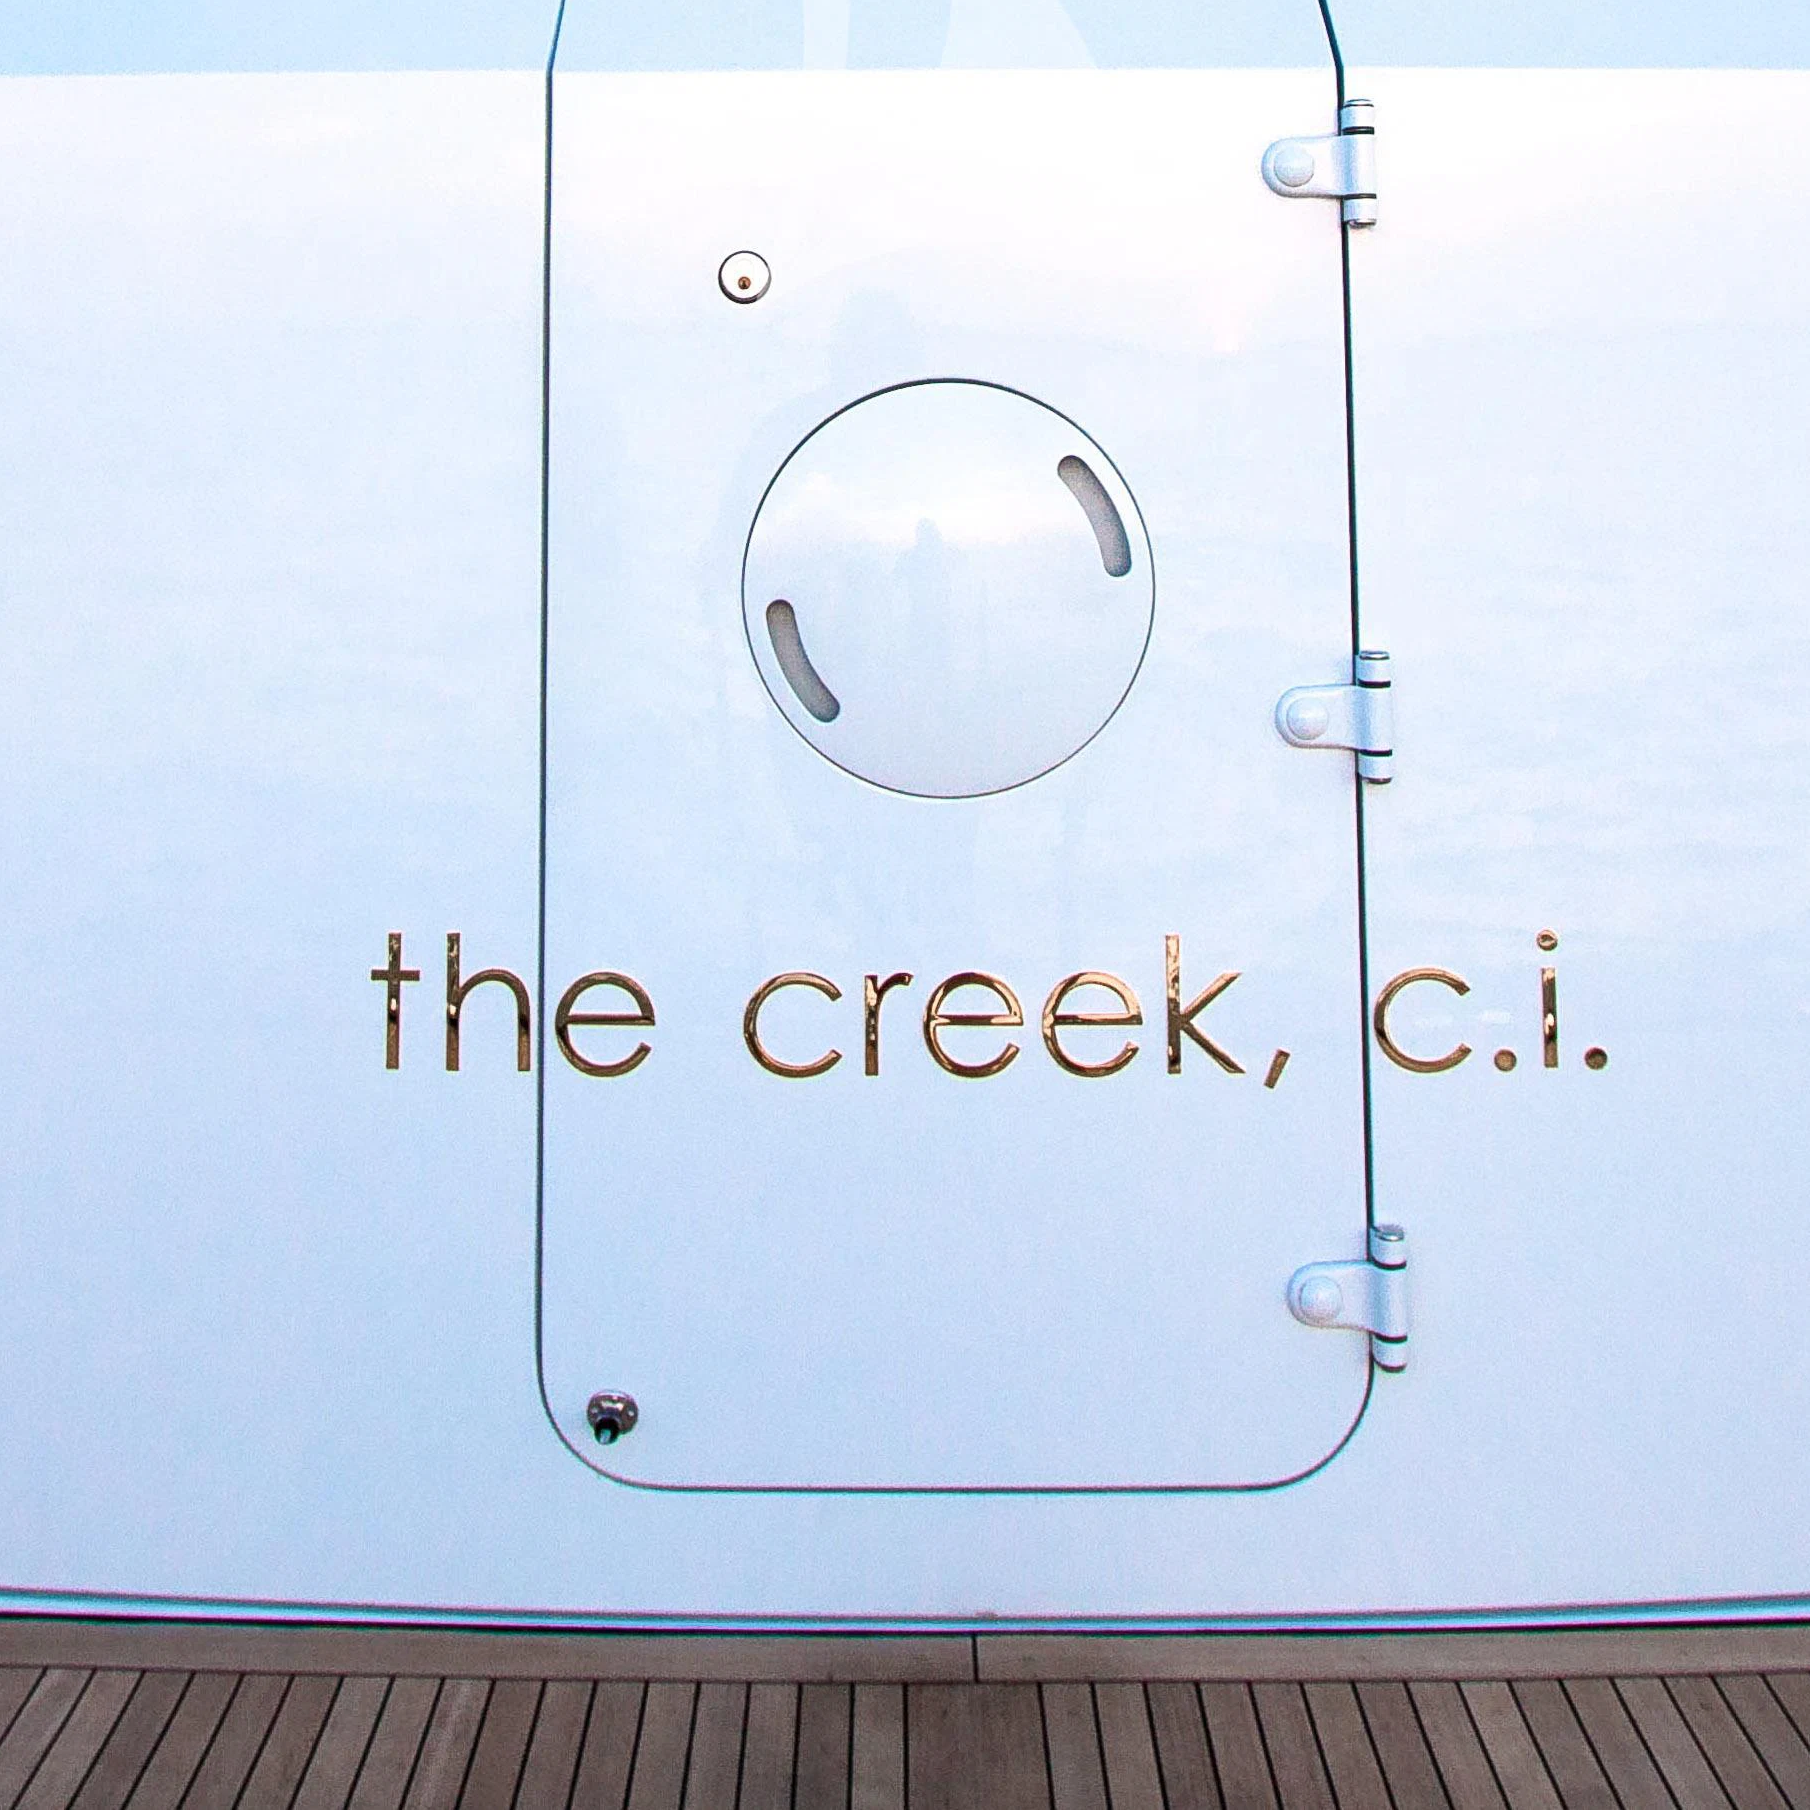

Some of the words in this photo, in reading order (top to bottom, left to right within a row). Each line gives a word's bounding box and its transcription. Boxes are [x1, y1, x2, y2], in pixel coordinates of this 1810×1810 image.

[368, 930, 658, 1080] the
[740, 932, 1293, 1092] creek,
[1371, 927, 1610, 1076] c.i.
